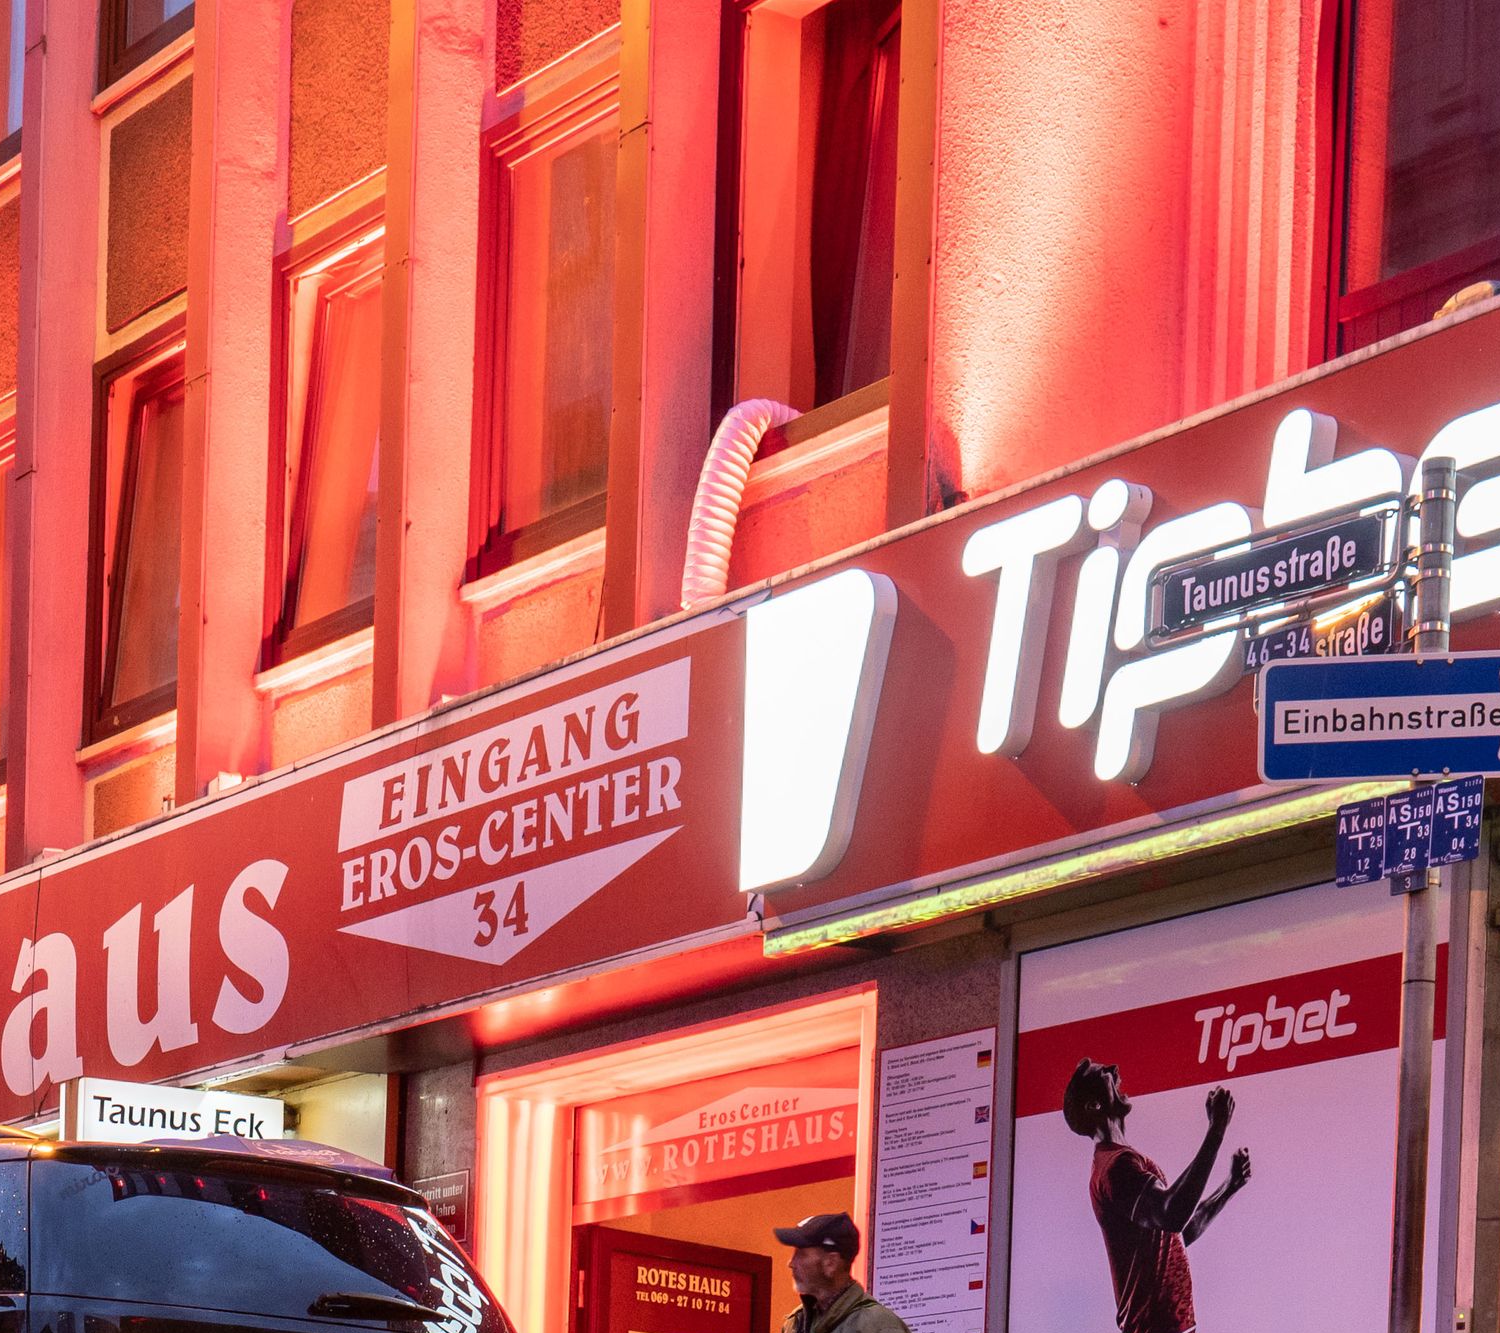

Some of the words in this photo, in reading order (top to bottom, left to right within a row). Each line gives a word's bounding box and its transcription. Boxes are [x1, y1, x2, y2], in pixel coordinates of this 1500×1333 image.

[1181, 535, 1357, 615] Taunusstraße
[379, 691, 641, 831] EINGANG
[339, 755, 683, 912] EROS-CENTER
[472, 880, 529, 948] 34
[1194, 987, 1358, 1073] Tipbet
[92, 1094, 202, 1135] Taunus
[214, 1108, 265, 1139] Eck
[442, 1183, 463, 1197] unter
[635, 1290, 650, 1302] TEL
[650, 1291, 669, 1304] 069
[676, 1295, 689, 1308] 27
[691, 1298, 702, 1310] 10
[705, 1299, 716, 1312] 77
[718, 1302, 730, 1314] 84
[636, 1265, 687, 1291] ROTES
[688, 1274, 731, 1298] HAUS
